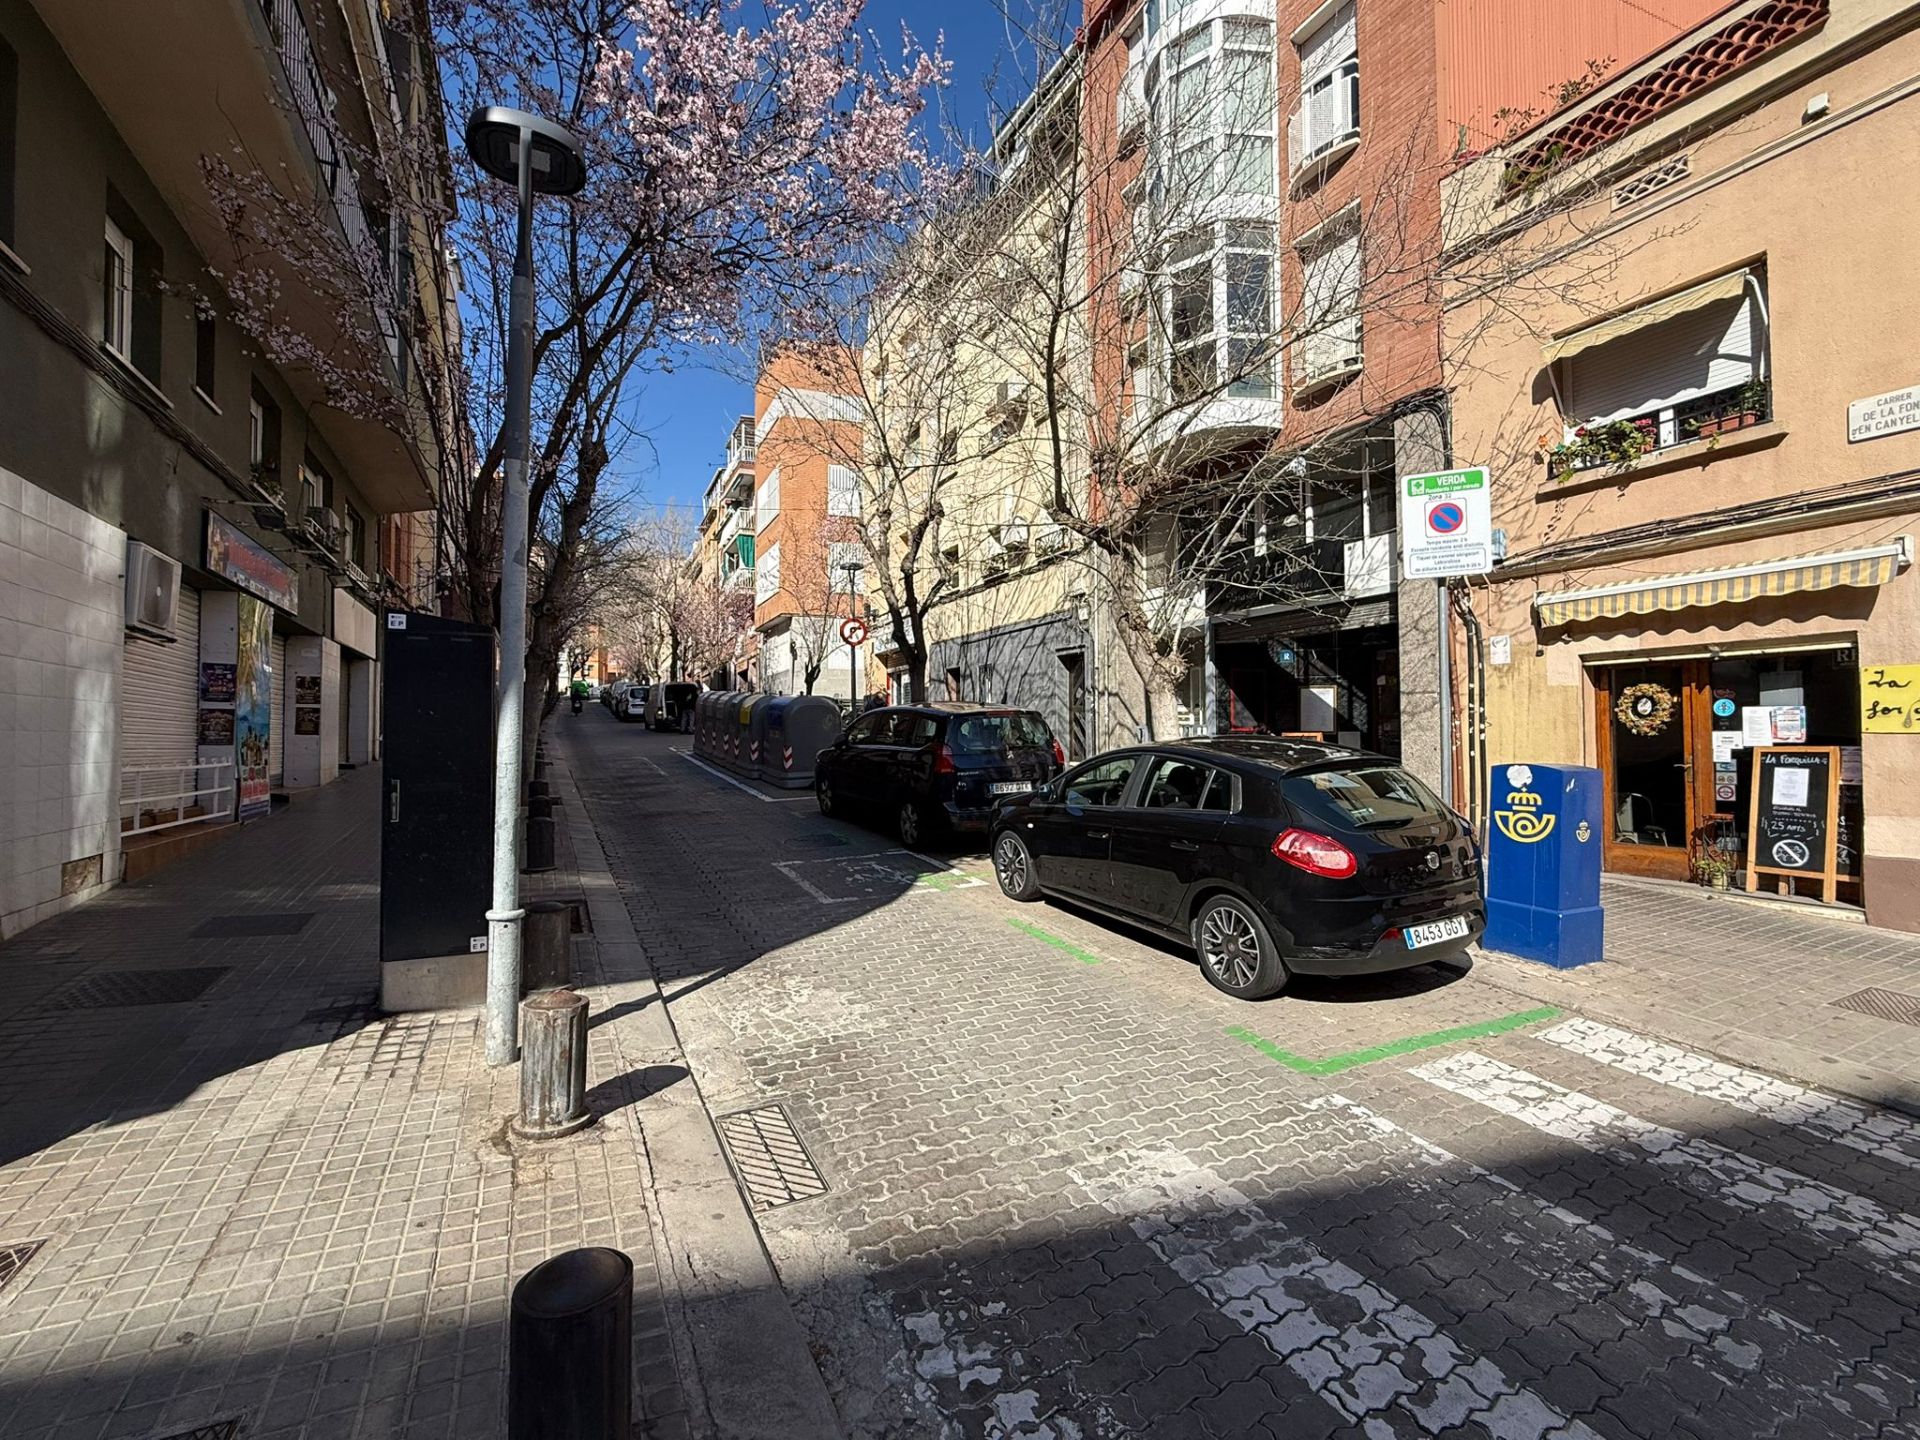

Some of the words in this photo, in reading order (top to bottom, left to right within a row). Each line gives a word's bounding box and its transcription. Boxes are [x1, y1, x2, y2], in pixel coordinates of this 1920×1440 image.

[1877, 392, 1912, 406] CARRER
[1863, 411, 1876, 421] DE
[1880, 407, 1895, 417] LA
[1899, 401, 1920, 414] FON
[1875, 414, 1920, 431] CANYEL
[1437, 474, 1466, 486] VERDA
[1868, 669, 1912, 688] La
[1765, 754, 1776, 764] LA
[1771, 821, 1784, 831] 25
[1414, 924, 1443, 944] 8453
[1445, 919, 1465, 936] GGY
